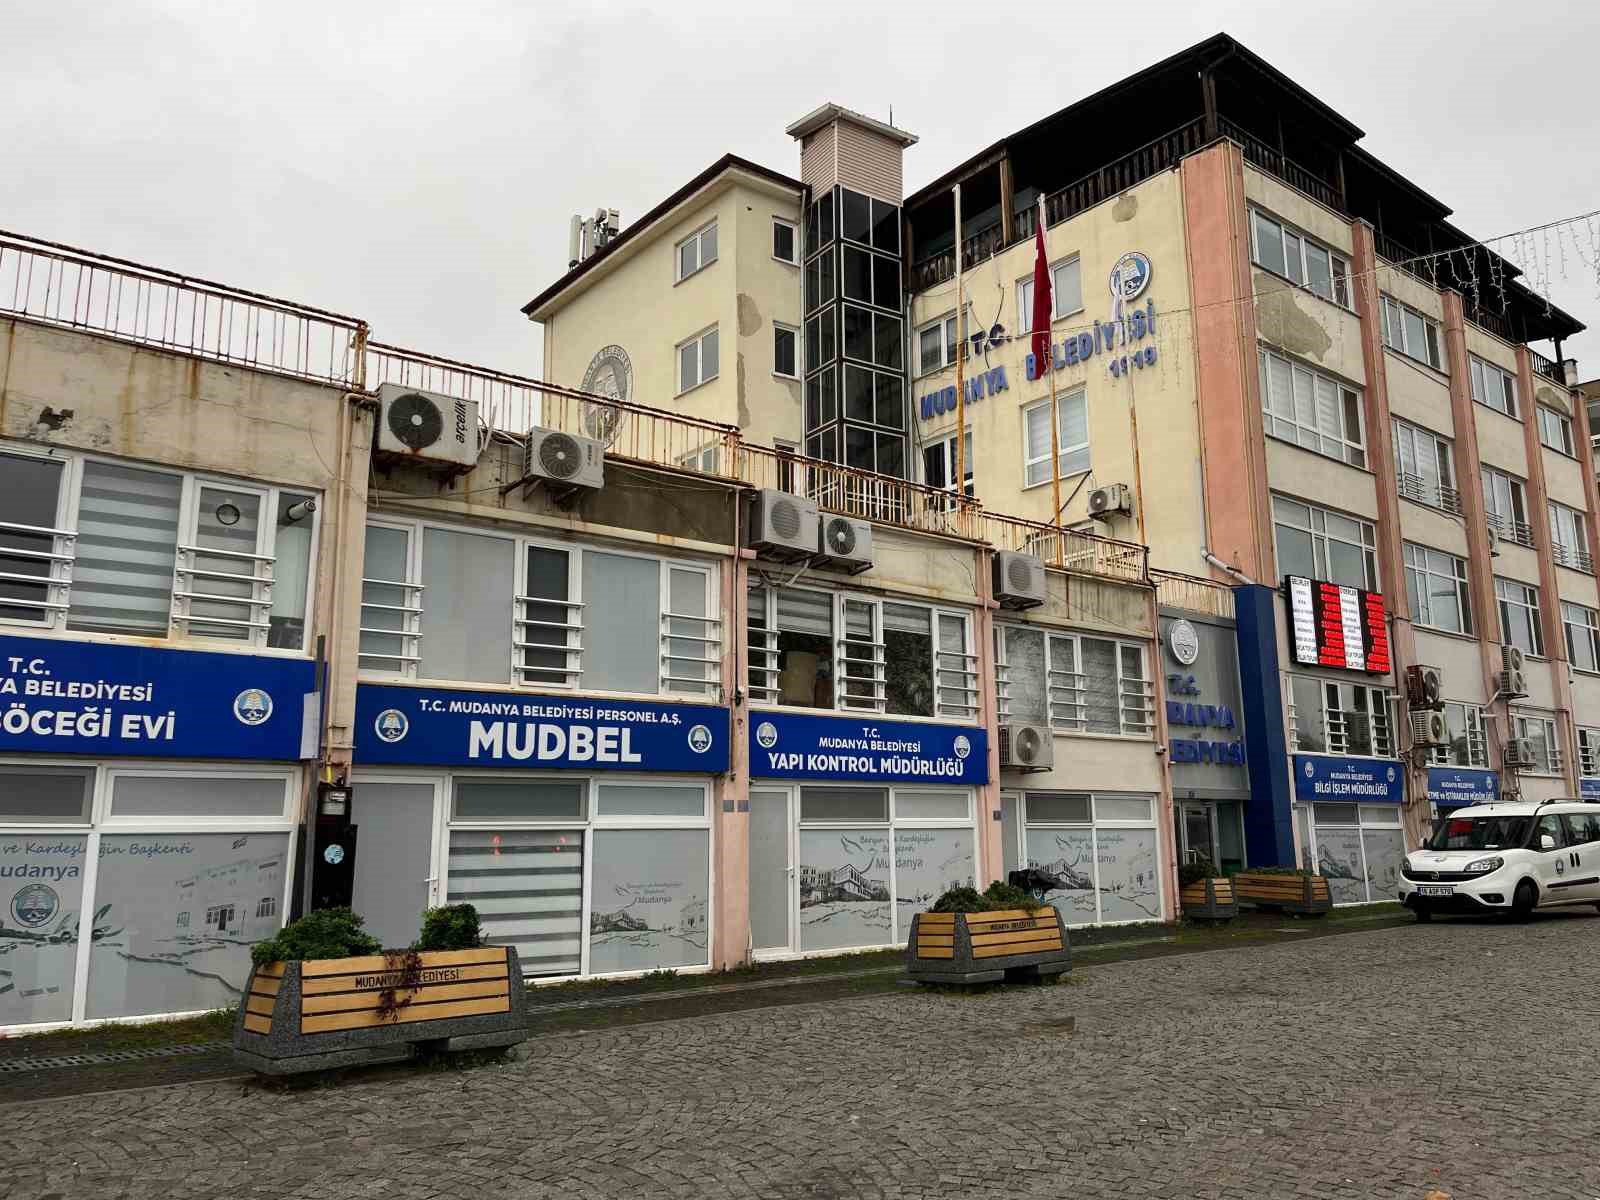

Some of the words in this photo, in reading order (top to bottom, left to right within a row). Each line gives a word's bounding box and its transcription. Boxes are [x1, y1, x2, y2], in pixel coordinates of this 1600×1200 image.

[8, 657, 51, 675] T.C.
[24, 680, 153, 702] BELEDİYESİ
[0, 702, 112, 738] ÖCEĞİ
[120, 711, 176, 740] EVİ
[419, 699, 446, 712] T.C.
[449, 701, 520, 716] MUDANYA
[522, 704, 594, 720] BELEDİYESİ
[596, 709, 658, 723] PERSONEL
[660, 713, 682, 726] A.Ş.
[468, 720, 642, 763] MUDBEL
[862, 728, 881, 738] T.C.
[818, 737, 868, 750] MUDANYA
[870, 740, 921, 753] BELEDİYESİ
[768, 752, 803, 770] YAPI
[807, 755, 877, 773] KONTROL
[881, 756, 964, 777] MÜDÜRLÜĞÜ
[1314, 781, 1332, 794] BİLGİ
[1332, 782, 1351, 795] İŞLEM
[1351, 782, 1388, 796] MÜDÜRLÜĞÜ
[25, 841, 126, 858] Kardeşlğin
